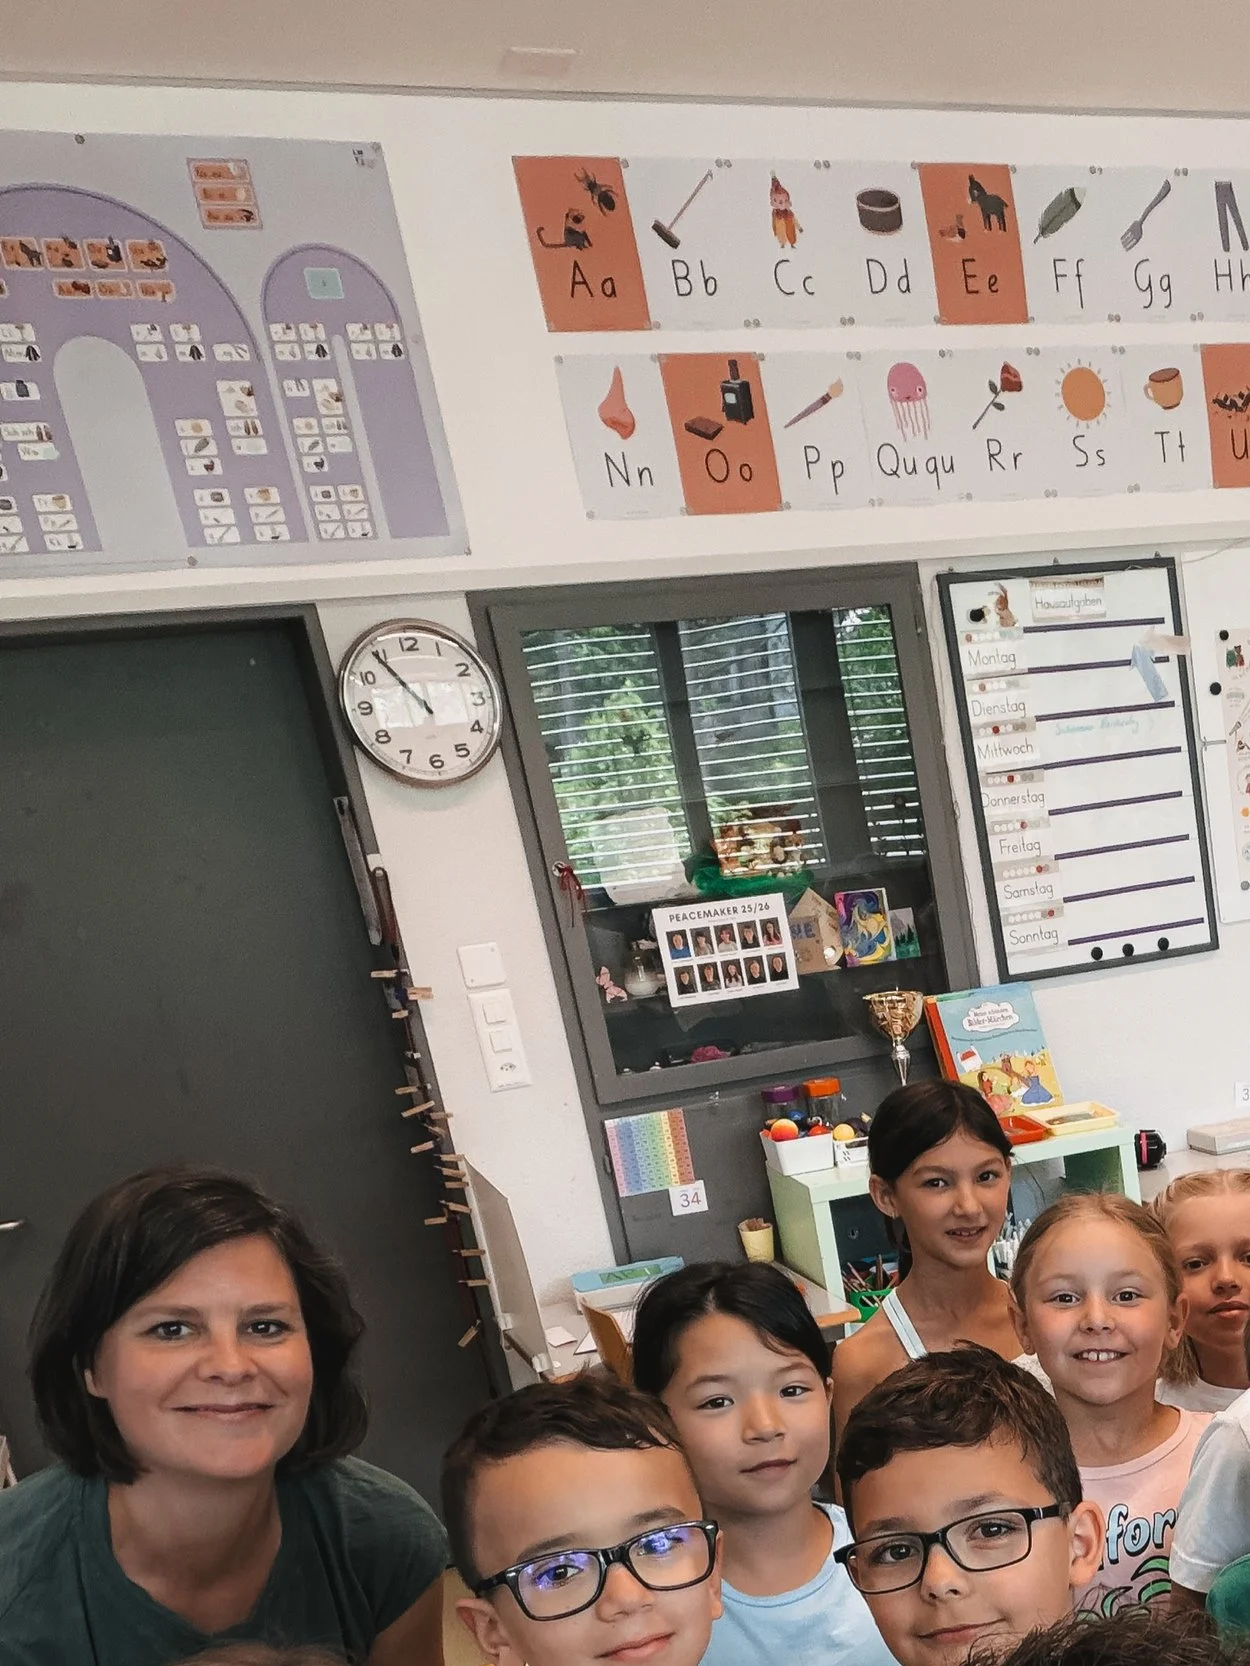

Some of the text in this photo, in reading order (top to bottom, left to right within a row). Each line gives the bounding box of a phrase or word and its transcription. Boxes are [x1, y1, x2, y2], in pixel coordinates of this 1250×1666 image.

[1035, 593, 1102, 612] Hausaufgaben
[399, 638, 419, 652] 12
[968, 649, 1016, 670] Montag
[456, 663, 470, 677] 2
[360, 671, 375, 686] 10
[470, 692, 485, 706] 3
[358, 702, 373, 715] 9
[972, 700, 1026, 718] Dienstag
[470, 720, 483, 733] 4
[375, 730, 391, 744] 8
[400, 750, 412, 764] 7
[455, 743, 470, 758] 5
[977, 740, 1035, 760] Mittwoch
[429, 754, 444, 768] 6
[982, 788, 1045, 808] Donnerstag
[999, 837, 1041, 857] Freitag
[1003, 882, 1053, 901] Samstag
[669, 902, 770, 923] PEACEMAKER 25/26
[1009, 928, 1059, 948] Sonntag
[680, 1192, 701, 1208] 34
